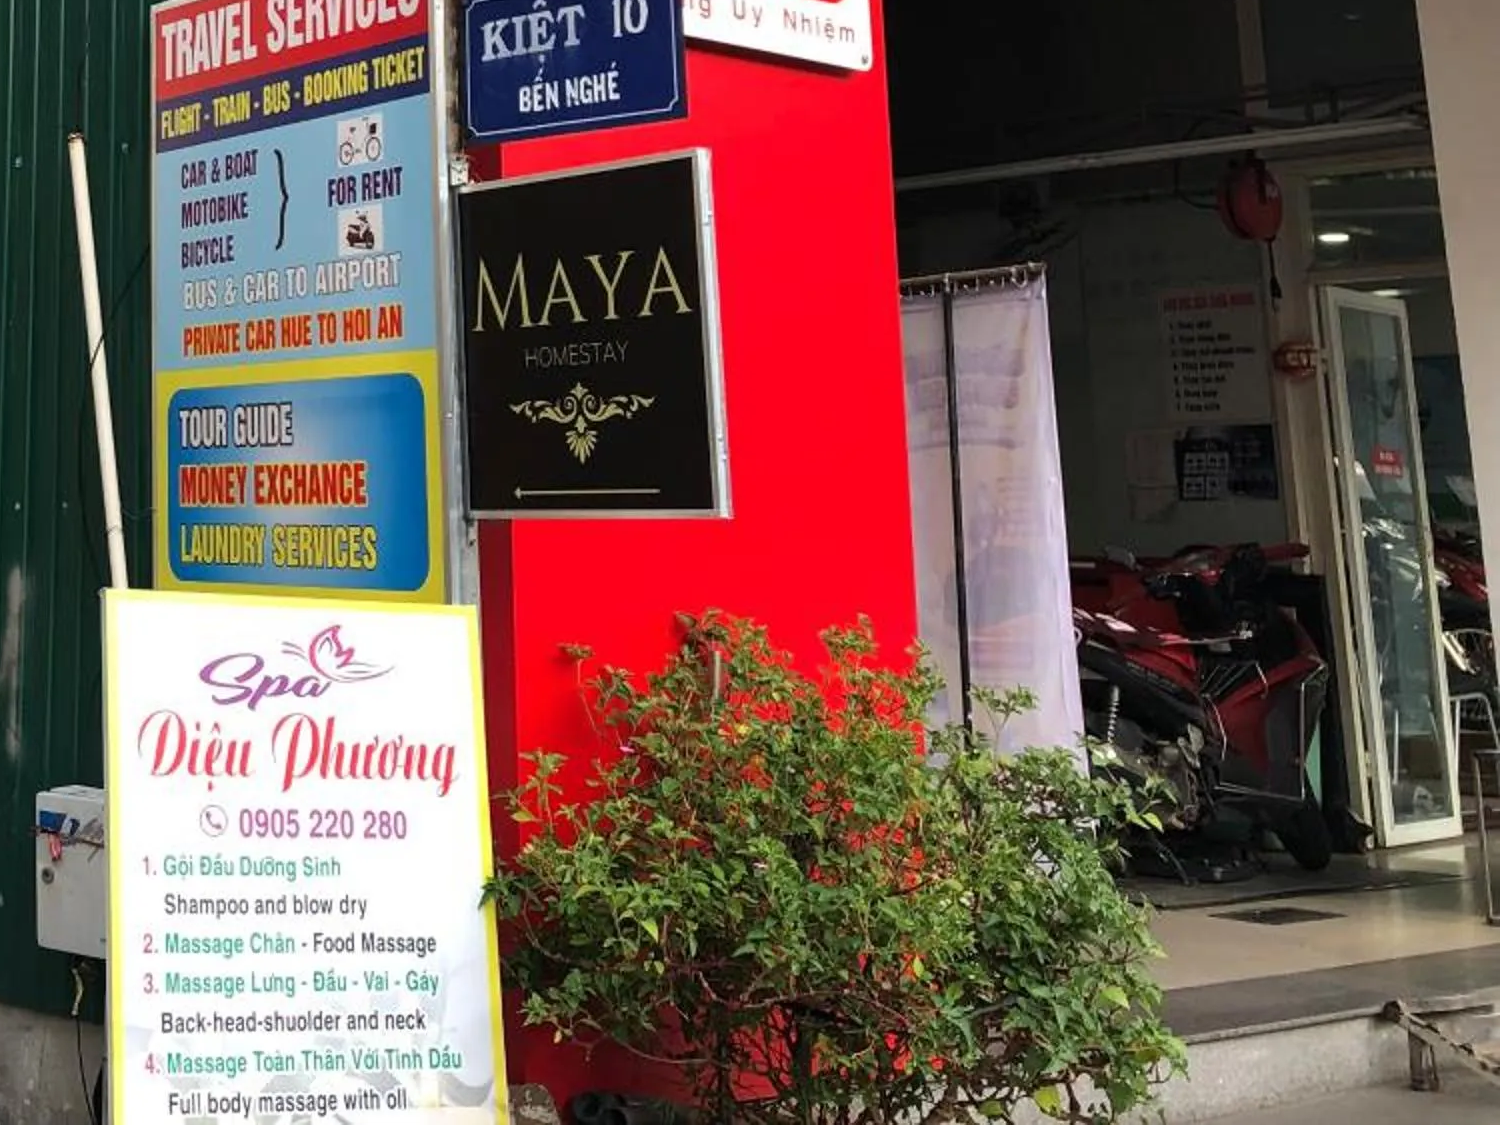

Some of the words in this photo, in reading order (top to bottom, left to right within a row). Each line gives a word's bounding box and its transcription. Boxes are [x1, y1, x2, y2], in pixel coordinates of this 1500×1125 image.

[783, 7, 856, 44] Nhiệm
[161, 101, 202, 140] FLIGHT
[212, 91, 251, 128] TRAIN
[263, 80, 291, 116] BUS
[303, 65, 368, 106] BOOKING
[371, 47, 426, 90] TICKET
[517, 64, 560, 114] BẾN
[565, 60, 621, 107] NGHÉ
[180, 161, 208, 190] CAR
[211, 157, 221, 184] &
[225, 149, 258, 182] BOAT
[327, 174, 357, 208] FOR
[361, 166, 404, 201] RENT
[180, 191, 249, 230] MOTOBIKE
[180, 235, 235, 269] BICYCLE
[183, 278, 218, 311] BUS
[224, 276, 238, 306] &
[243, 270, 280, 305] CAR
[286, 265, 308, 299] TO
[314, 251, 402, 297] AIRPORT
[471, 244, 693, 333] MAYA
[183, 321, 241, 358] PRIVATE
[245, 318, 276, 352] CAR
[281, 313, 312, 348] HUE
[316, 310, 336, 345] TO
[342, 307, 371, 342] HOI
[377, 303, 404, 339] AN
[525, 339, 630, 369] HOMESTAY
[179, 405, 228, 450] TOUR
[232, 400, 294, 448] GUIDE
[179, 463, 248, 507] MONEY
[252, 459, 368, 507] EXCHANGE
[180, 523, 267, 567] LAUNDRY
[271, 524, 378, 571] SERVICES
[199, 652, 334, 711] Spa
[137, 709, 256, 793] Diệu
[271, 712, 460, 799] Phương
[238, 807, 301, 840] 0905
[308, 809, 355, 839] 220
[362, 809, 408, 840] 280
[142, 856, 157, 876] 1.
[302, 855, 342, 877] Sinh
[164, 892, 250, 920] Shampoo
[254, 894, 288, 916] and
[293, 894, 334, 915] blow
[339, 894, 367, 920] dry
[142, 933, 159, 955] 2.
[165, 932, 245, 960] Massage
[313, 932, 356, 953] Food
[361, 931, 437, 958] Massage
[143, 973, 160, 995] 3.
[165, 971, 246, 999] Massage
[250, 971, 296, 998] Lưng
[363, 970, 390, 992] Vai
[346, 1011, 380, 1031] and
[385, 1009, 426, 1030] neck
[144, 1052, 161, 1074] 4.
[166, 1051, 248, 1079] Massage
[301, 1049, 346, 1071] Thân
[168, 1092, 202, 1116] Full
[207, 1092, 252, 1119] body
[258, 1090, 338, 1117] massage
[343, 1088, 381, 1110] with
